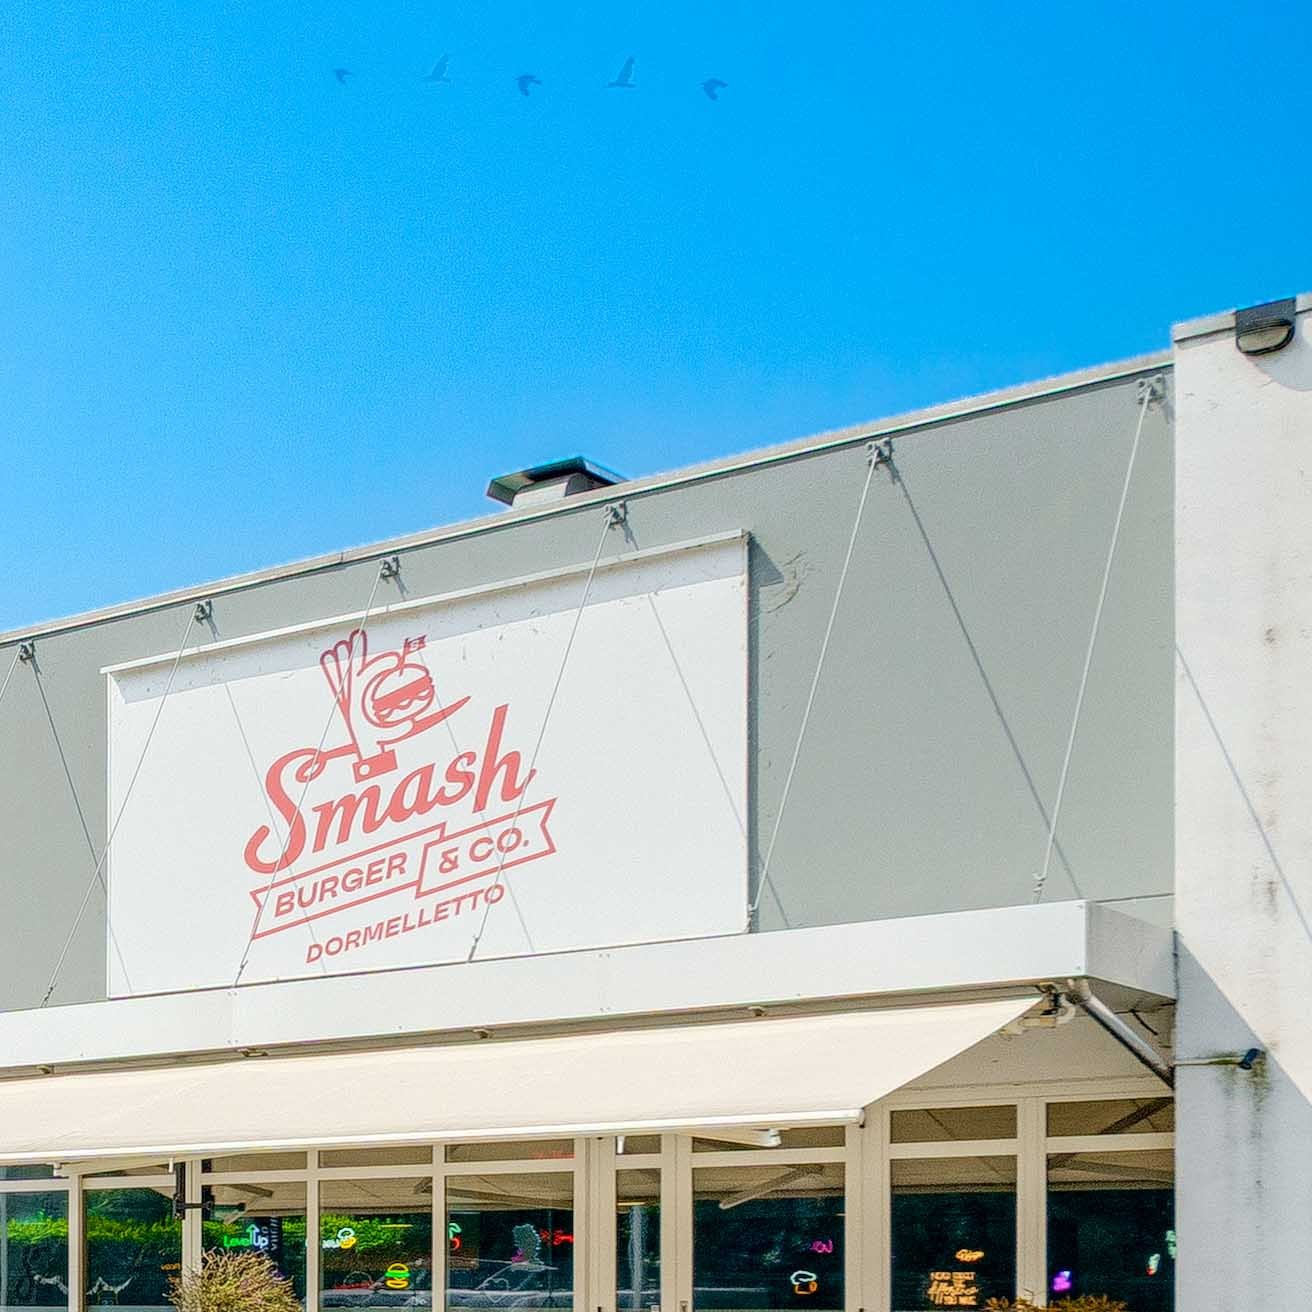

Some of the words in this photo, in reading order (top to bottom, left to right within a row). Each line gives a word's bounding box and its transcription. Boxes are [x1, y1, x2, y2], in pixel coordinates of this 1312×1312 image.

[244, 703, 537, 874] Smash
[274, 851, 408, 918] BURGER
[438, 846, 460, 874] &
[468, 827, 530, 863] CO.
[306, 883, 506, 964] DORMELLETTO
